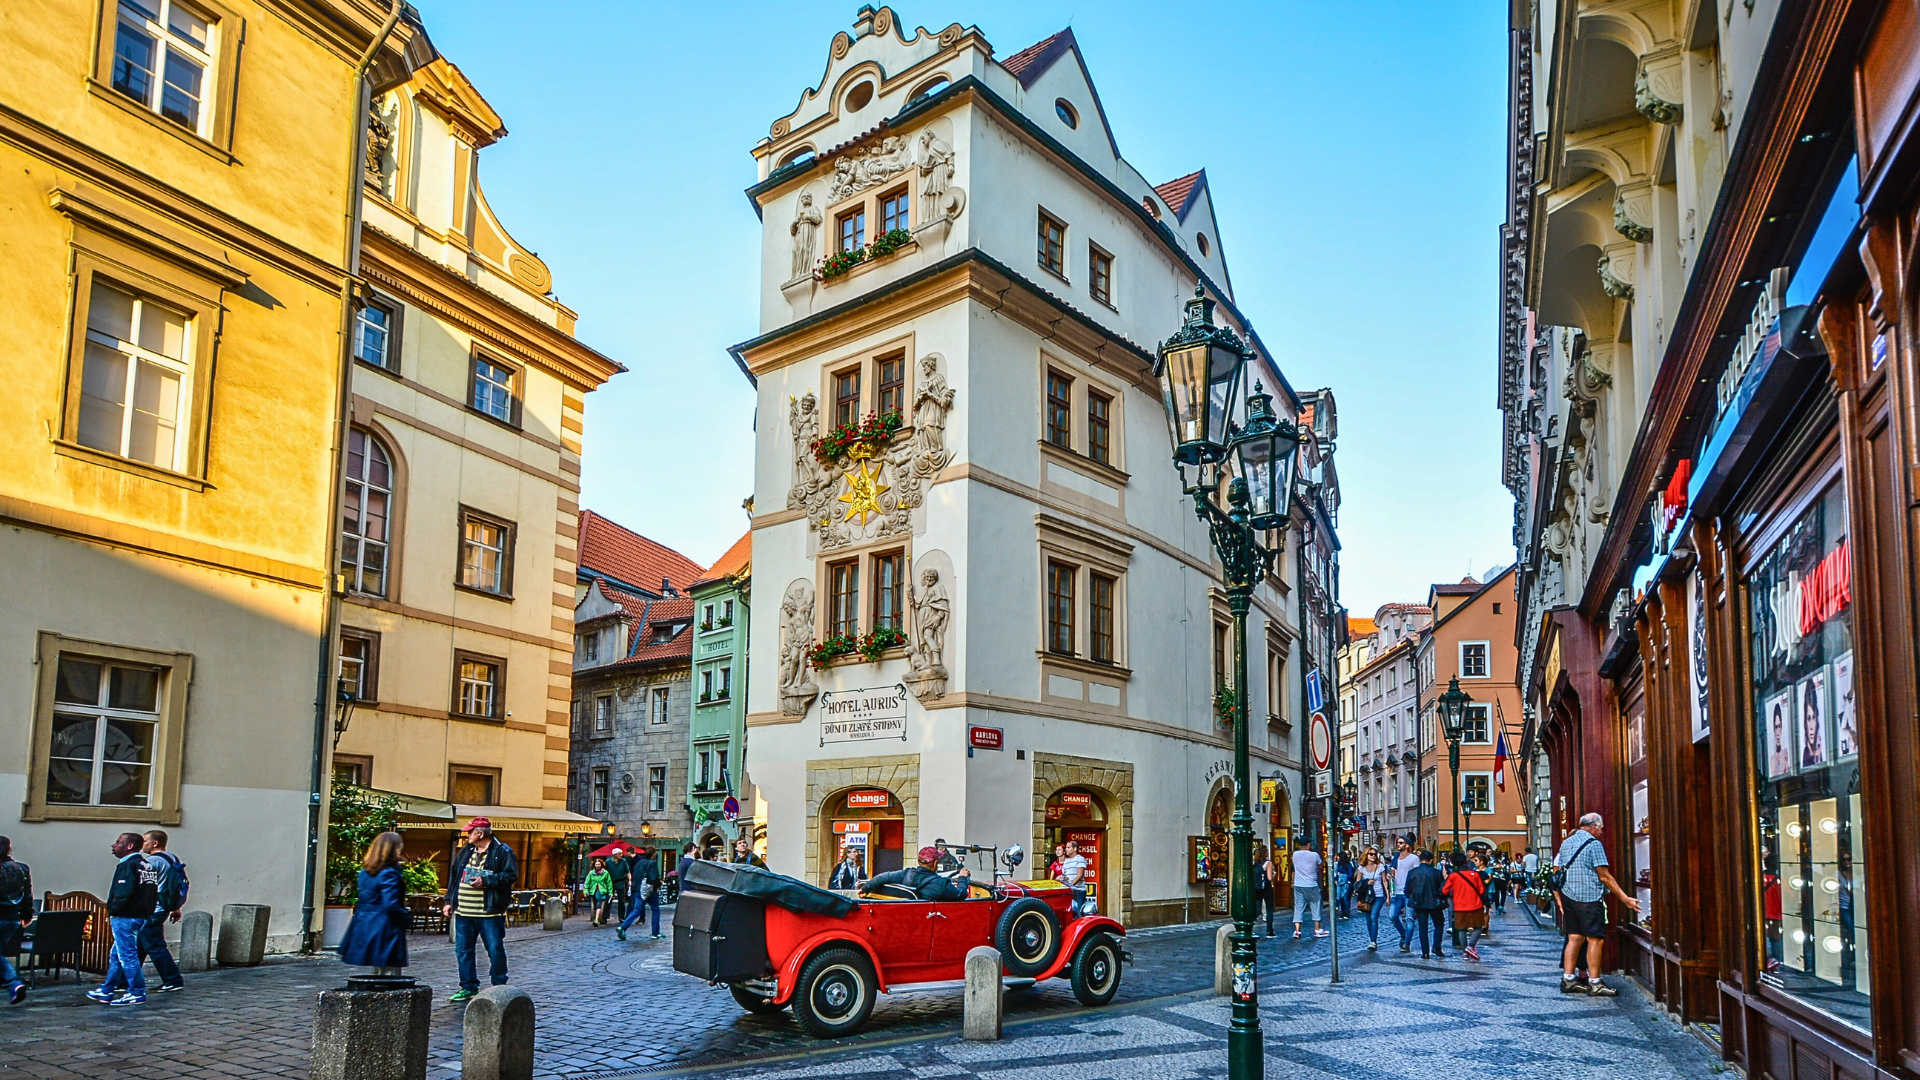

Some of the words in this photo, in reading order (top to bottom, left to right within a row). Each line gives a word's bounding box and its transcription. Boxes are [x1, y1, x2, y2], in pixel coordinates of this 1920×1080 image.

[707, 640, 729, 652] HOTEL
[828, 699, 861, 715] HOTEL
[861, 695, 899, 712] AURUS
[842, 724, 847, 733] U
[848, 719, 872, 733] ZLATÉ
[873, 719, 903, 731] STUDNY
[975, 731, 998, 740] KARLOVA
[1204, 759, 1236, 785] KERAMI
[850, 793, 886, 804] change
[1063, 795, 1089, 803] CHANGE
[491, 821, 541, 830] RESTAURANT
[554, 823, 594, 832] CLEMENTIN
[844, 822, 860, 832] ATM
[849, 836, 866, 844] ATM
[1070, 833, 1096, 841] CHANGE
[1084, 870, 1096, 878] BIO
